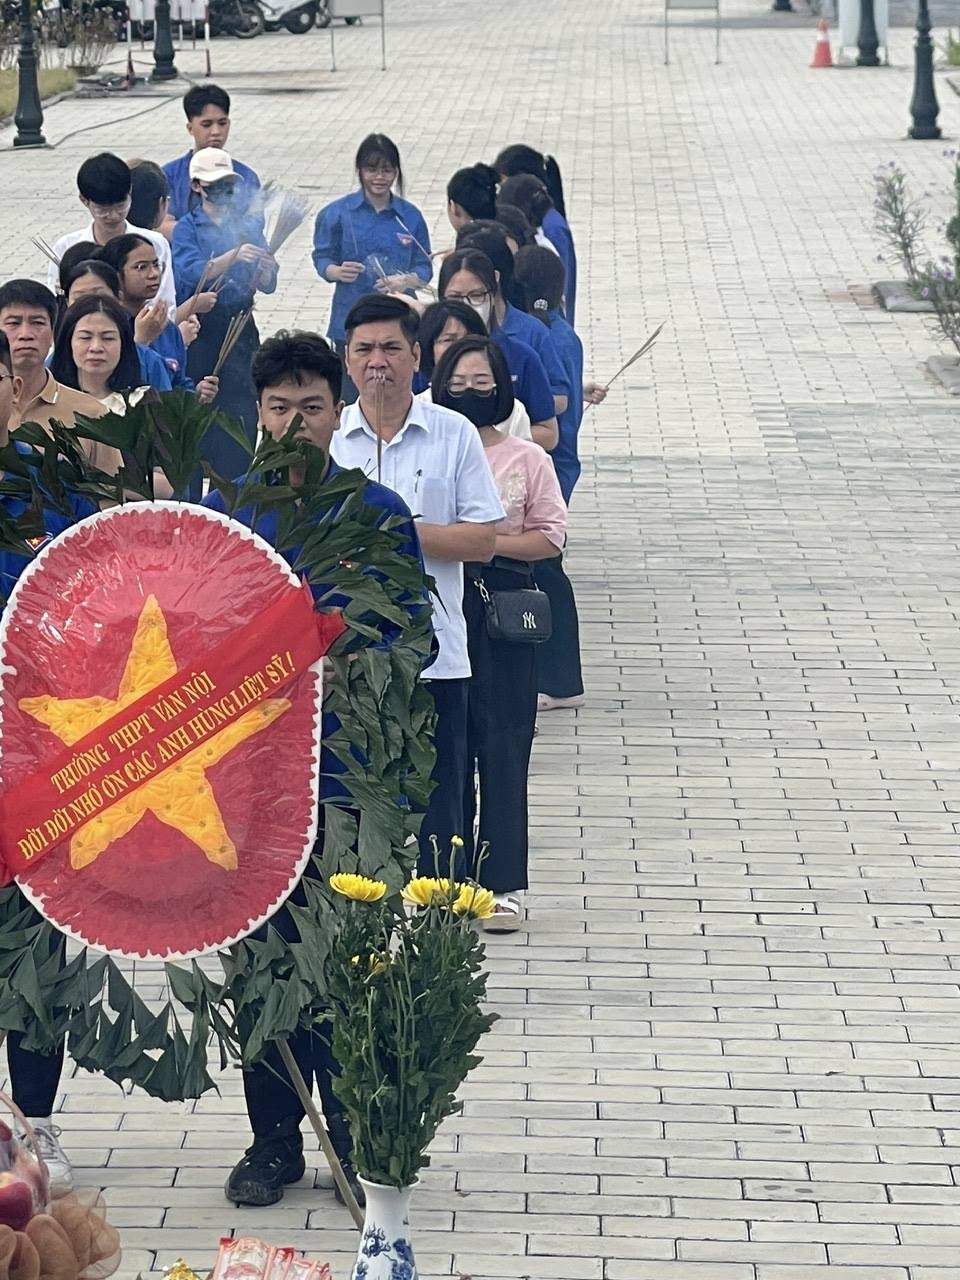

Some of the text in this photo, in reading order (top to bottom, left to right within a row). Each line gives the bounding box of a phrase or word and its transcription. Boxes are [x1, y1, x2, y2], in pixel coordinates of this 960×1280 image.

[522, 611, 537, 629] NY
[16, 827, 49, 860] ĐỜI
[43, 807, 75, 841] ĐỜI
[68, 781, 104, 822] NHỚ
[101, 769, 128, 798] ƠN
[123, 750, 157, 783] CÁC
[156, 726, 193, 763] ANH
[187, 696, 238, 740] HÙNG
[238, 671, 269, 710] LIỆT
[51, 670, 216, 794] TRƯỜNG THPT VÂN NỘI
